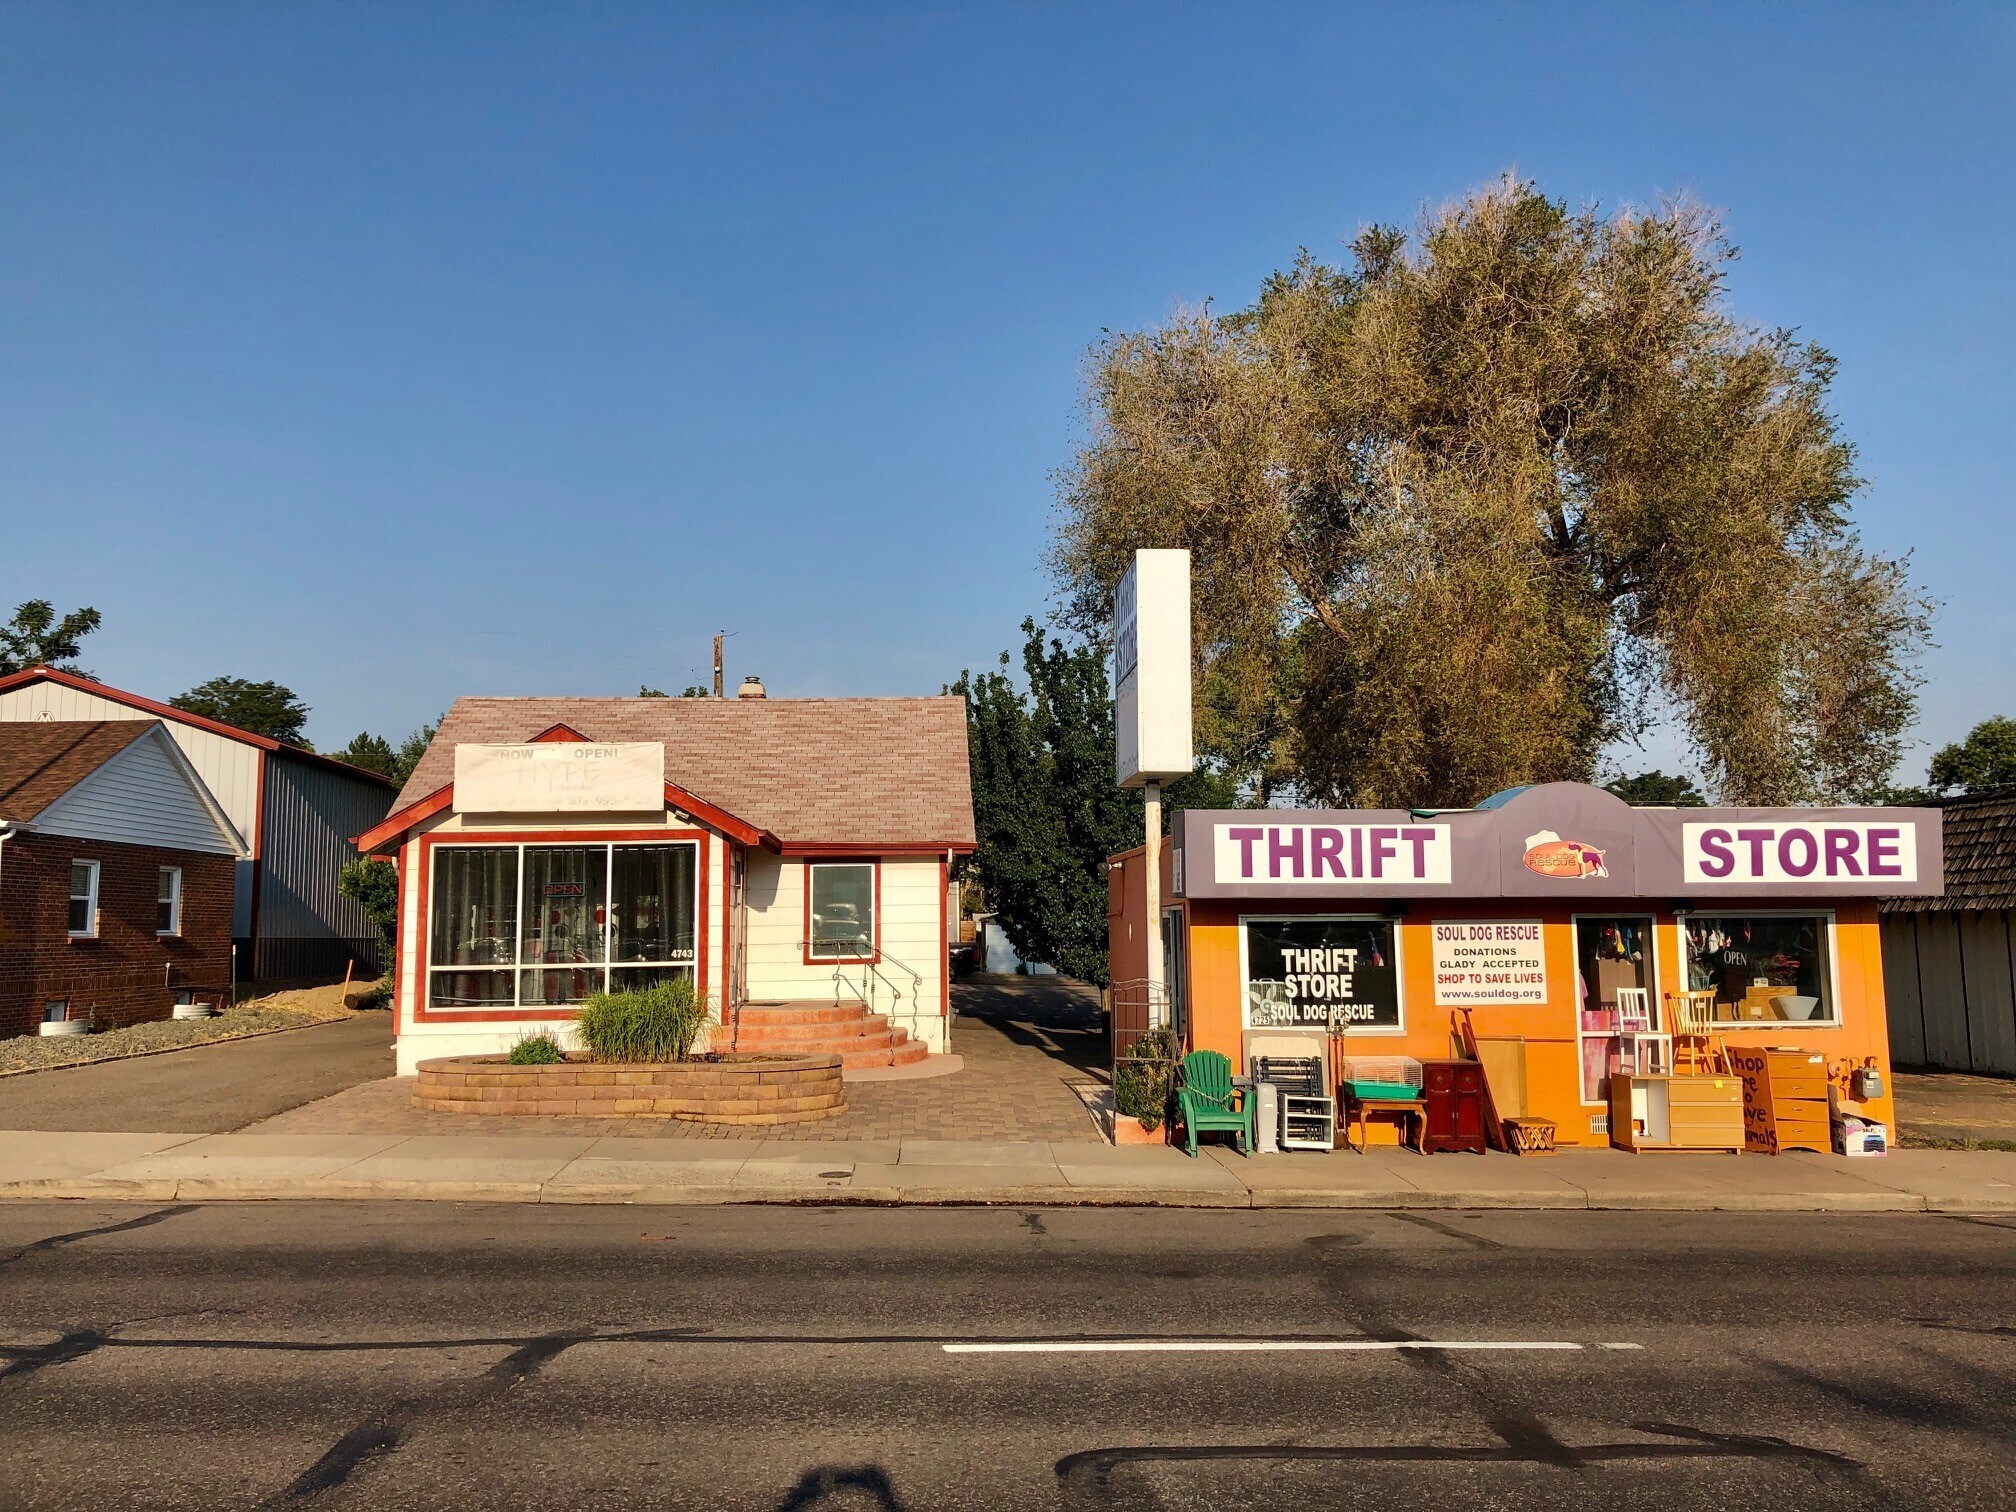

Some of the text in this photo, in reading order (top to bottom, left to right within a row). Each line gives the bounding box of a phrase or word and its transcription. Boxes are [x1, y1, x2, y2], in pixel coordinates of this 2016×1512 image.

[1115, 562, 1136, 629] THRIFT
[500, 749, 618, 760] NOW OPEN!
[517, 760, 602, 792] HYPE
[1229, 827, 1902, 878] THRIFT STORE
[543, 884, 582, 895] OPEN
[1437, 925, 1539, 941] SOUL DOG RESCUE
[671, 949, 693, 959] 4743
[1454, 947, 1517, 956] DONATIONS
[1723, 950, 1747, 966] OPEN
[1281, 948, 1358, 973] THRIFT
[1440, 960, 1539, 968] GLADY ACCEPTED
[1437, 973, 1543, 984] SHOP TO SAVE LIVES
[1284, 974, 1354, 998] STORE
[1441, 989, 1541, 999] www.souldog.org
[1270, 1003, 1375, 1021] SOUL DOG RESCUE
[1252, 1016, 1269, 1025] 4725
